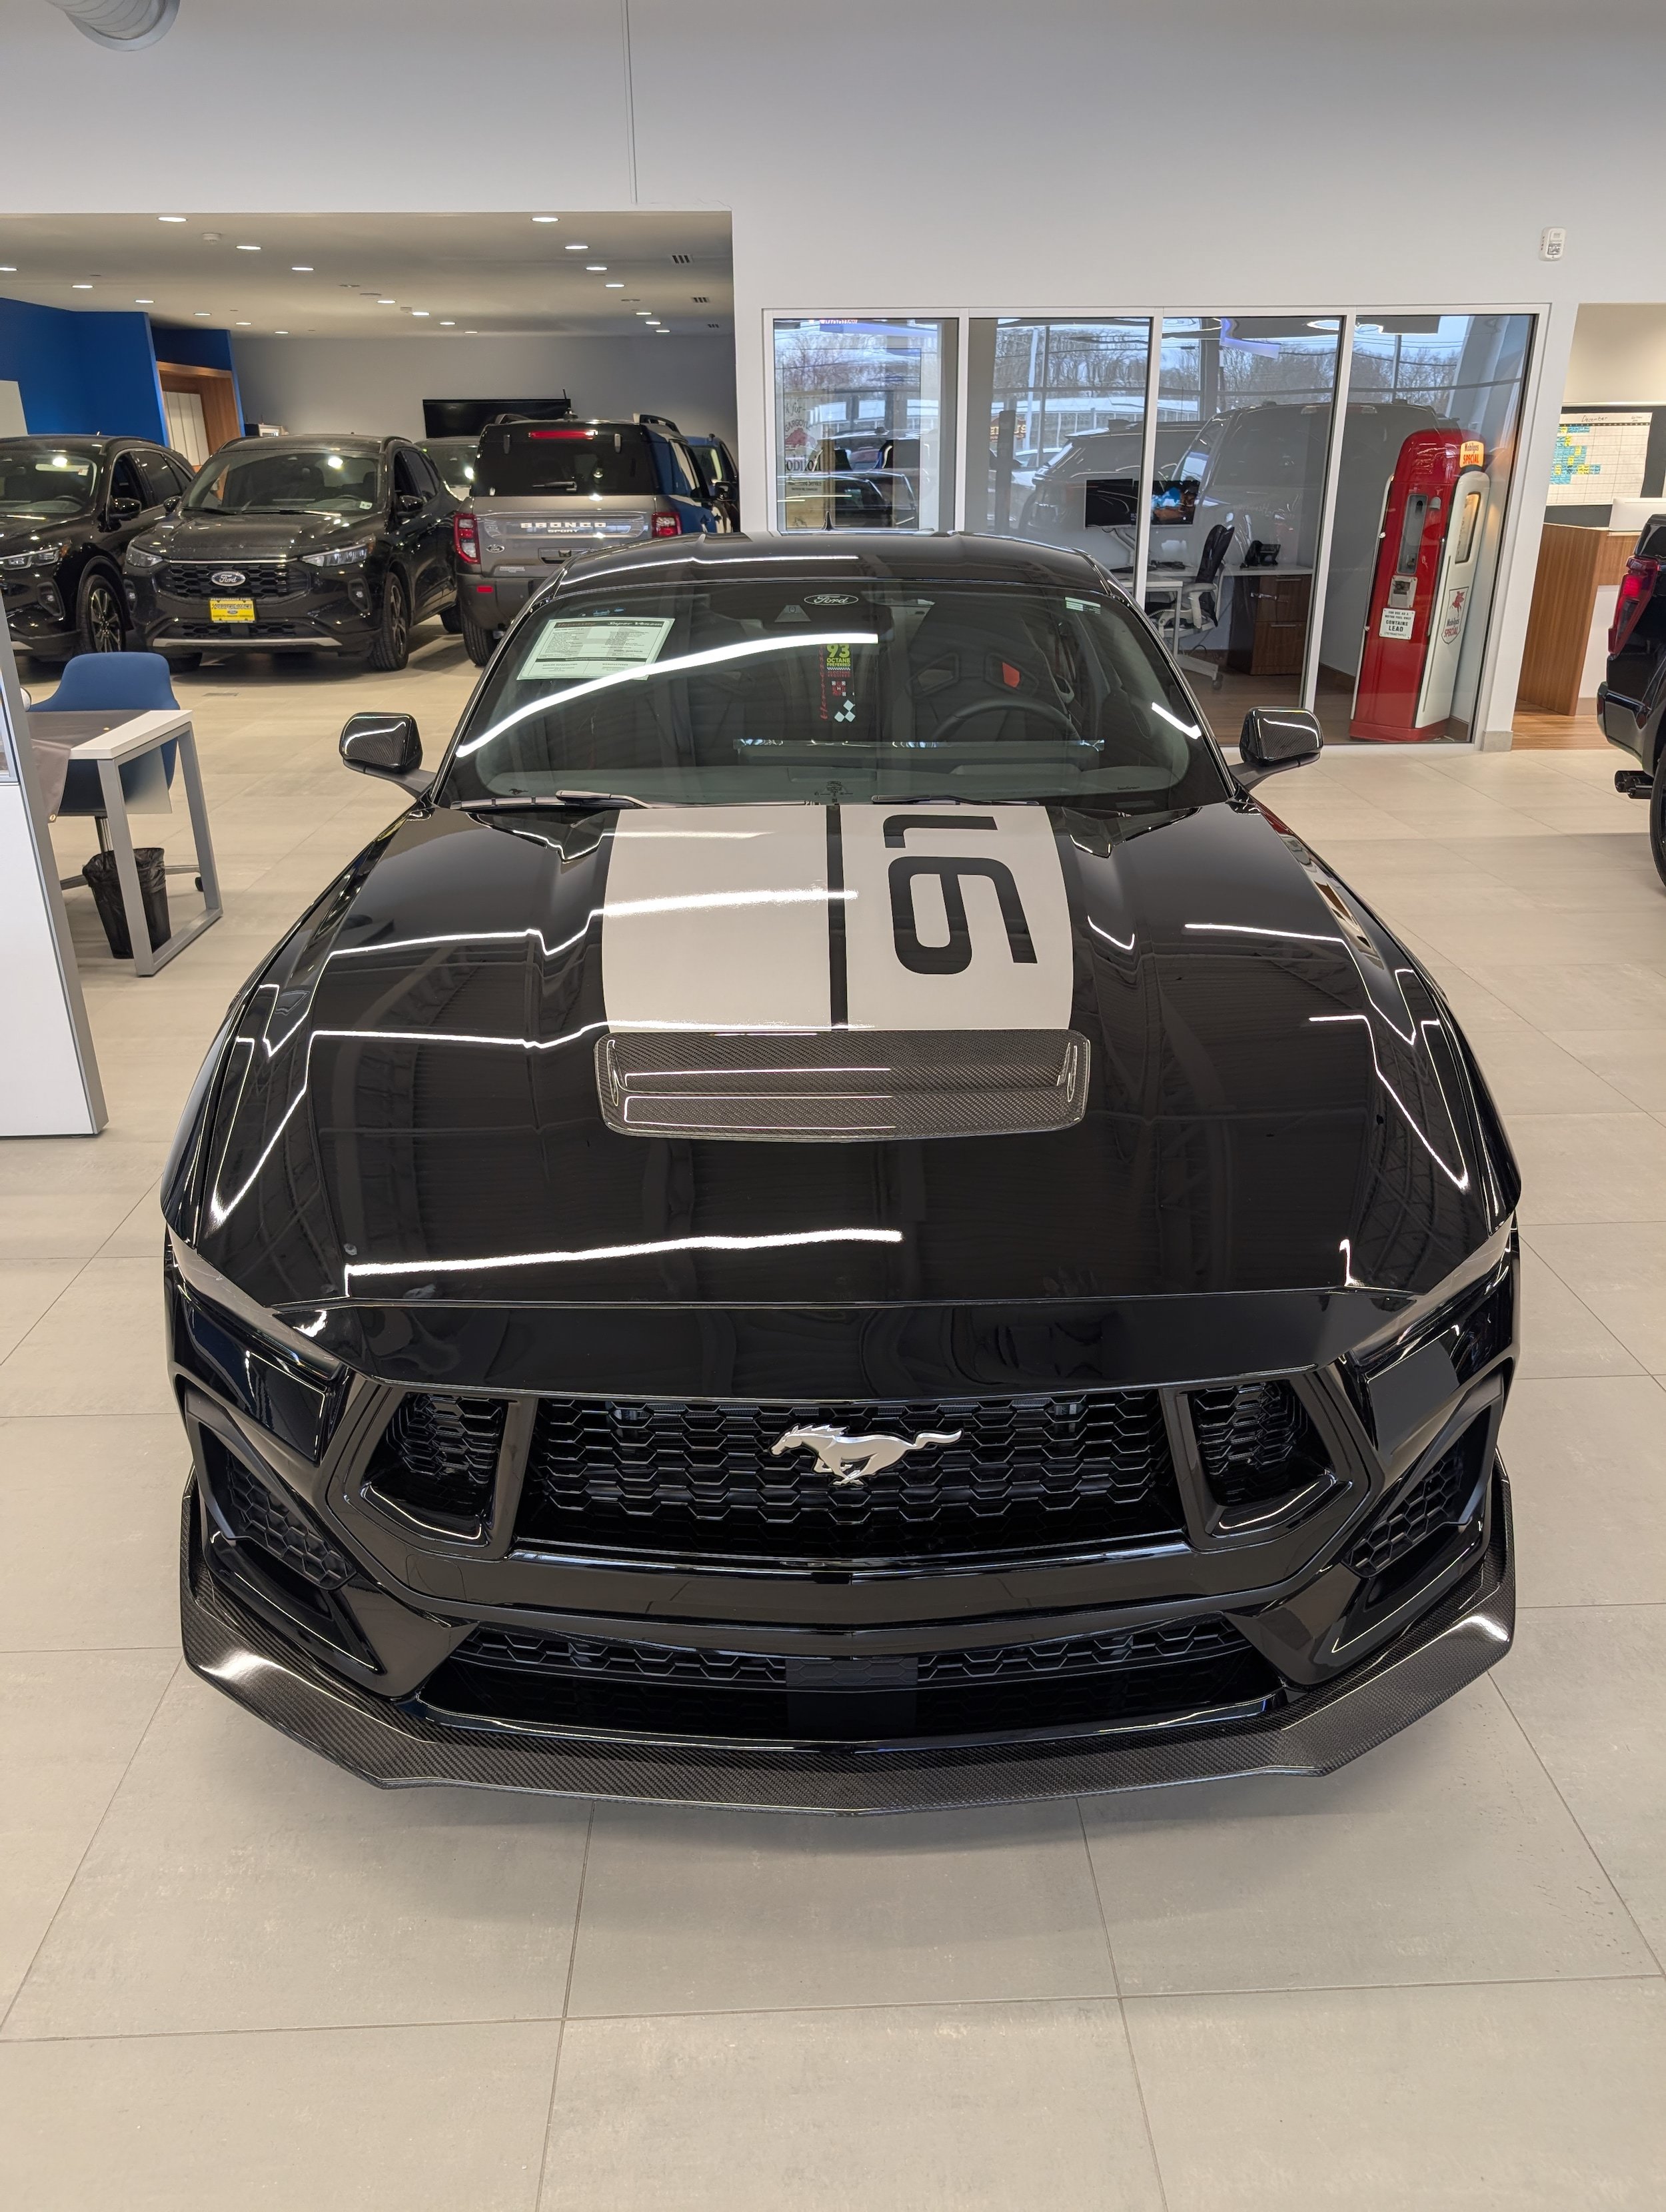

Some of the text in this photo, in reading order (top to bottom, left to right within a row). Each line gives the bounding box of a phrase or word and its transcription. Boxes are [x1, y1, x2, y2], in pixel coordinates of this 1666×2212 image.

[785, 454, 821, 472] obiloil
[1463, 454, 1479, 464] SPECIAL
[219, 574, 238, 583] Ford
[814, 595, 848, 604] Ford
[826, 643, 850, 658] 93
